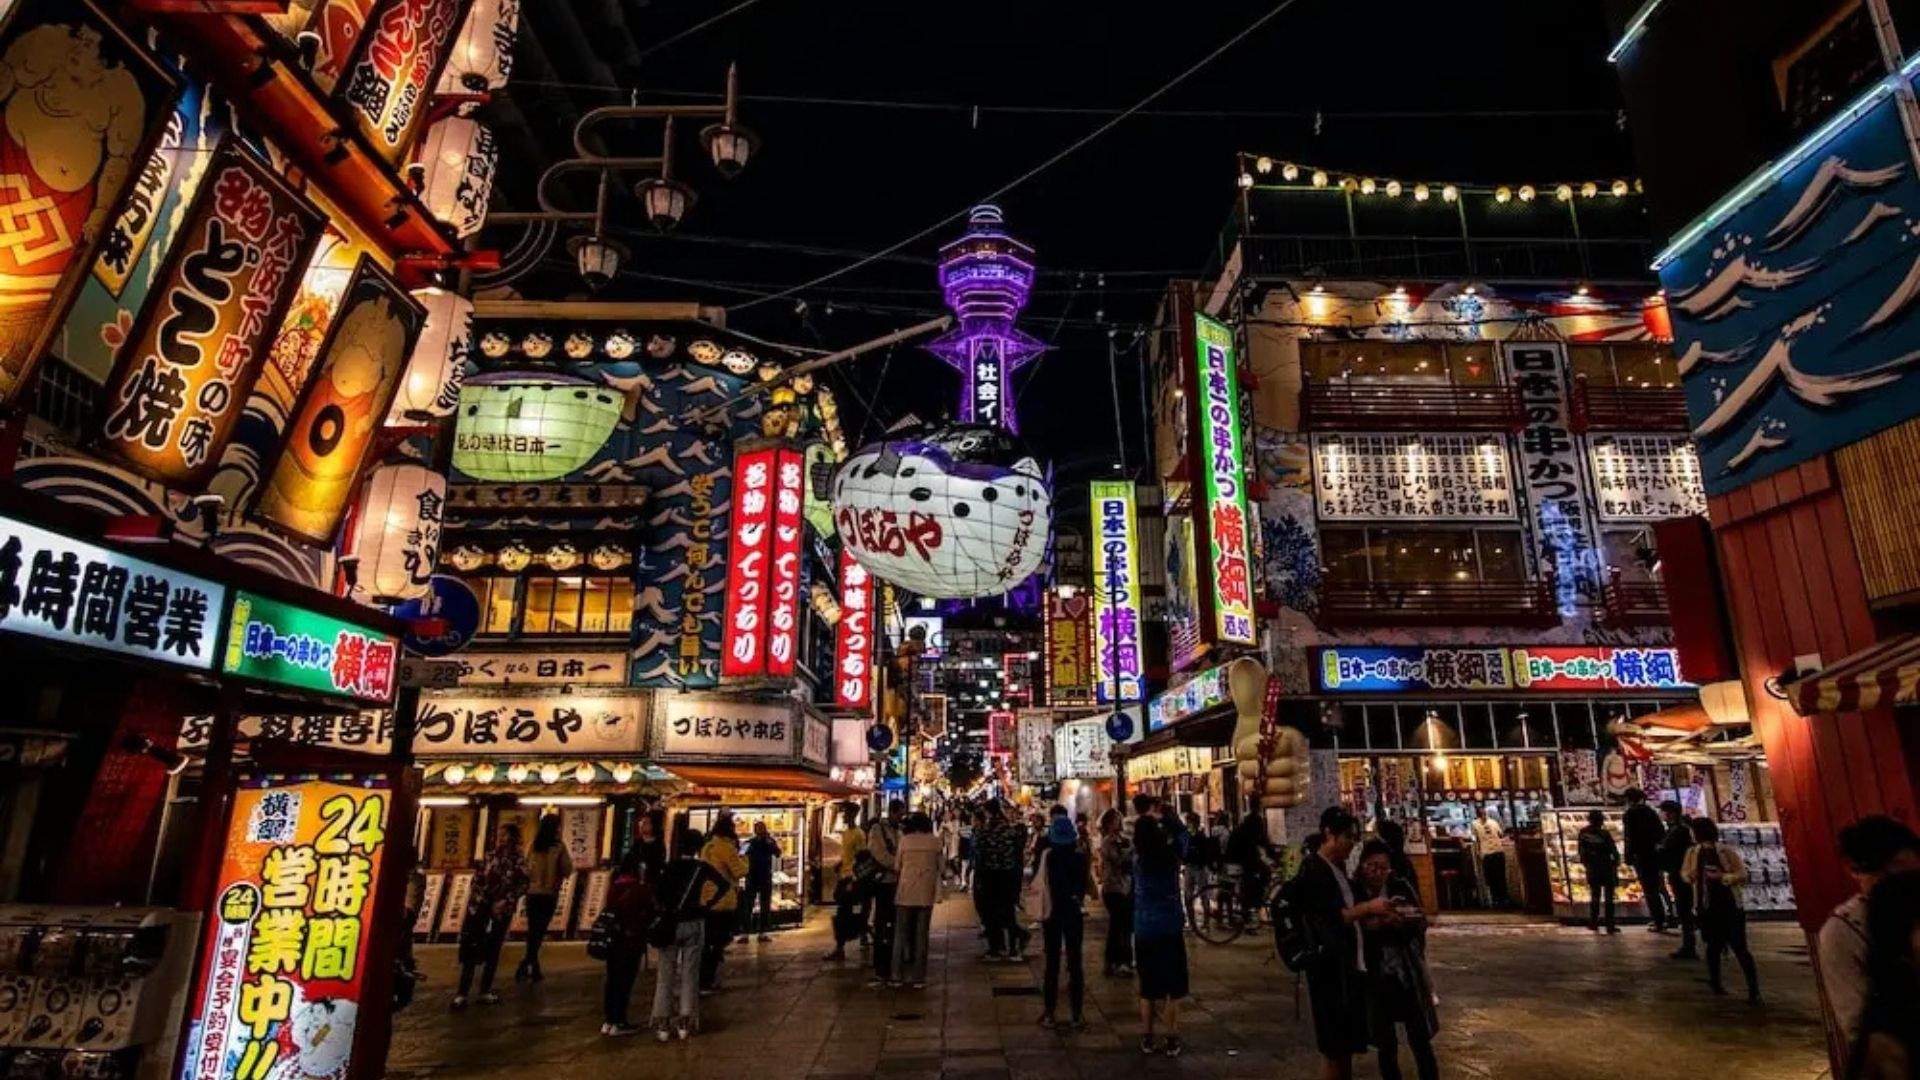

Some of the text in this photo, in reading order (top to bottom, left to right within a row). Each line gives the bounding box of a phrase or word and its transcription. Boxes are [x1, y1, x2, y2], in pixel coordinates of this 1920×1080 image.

[215, 167, 274, 241] 名物
[180, 214, 304, 467] 大阪下町の味
[977, 363, 999, 425] 社会イ
[1208, 346, 1236, 497] 日本一の串かつ
[1513, 350, 1578, 499] 日本一の串かつ
[1213, 500, 1249, 609] 横綱
[733, 551, 763, 664] てっちり
[771, 552, 797, 664] てっちり
[1100, 607, 1137, 678] 横綱
[243, 620, 331, 671] 日本一の串かつ
[331, 631, 396, 698] 横綱
[537, 659, 611, 678] 日本一
[1339, 657, 1424, 681] 日本一の串かつ
[1424, 650, 1488, 688] 横綱
[1529, 657, 1613, 680] 日本一の串かつ
[1613, 650, 1677, 687] 横綱
[418, 702, 582, 744] づぼらや
[672, 717, 785, 741] づぼらや本店
[302, 795, 386, 981] 24時間
[200, 949, 240, 1080] 宴会予約受付
